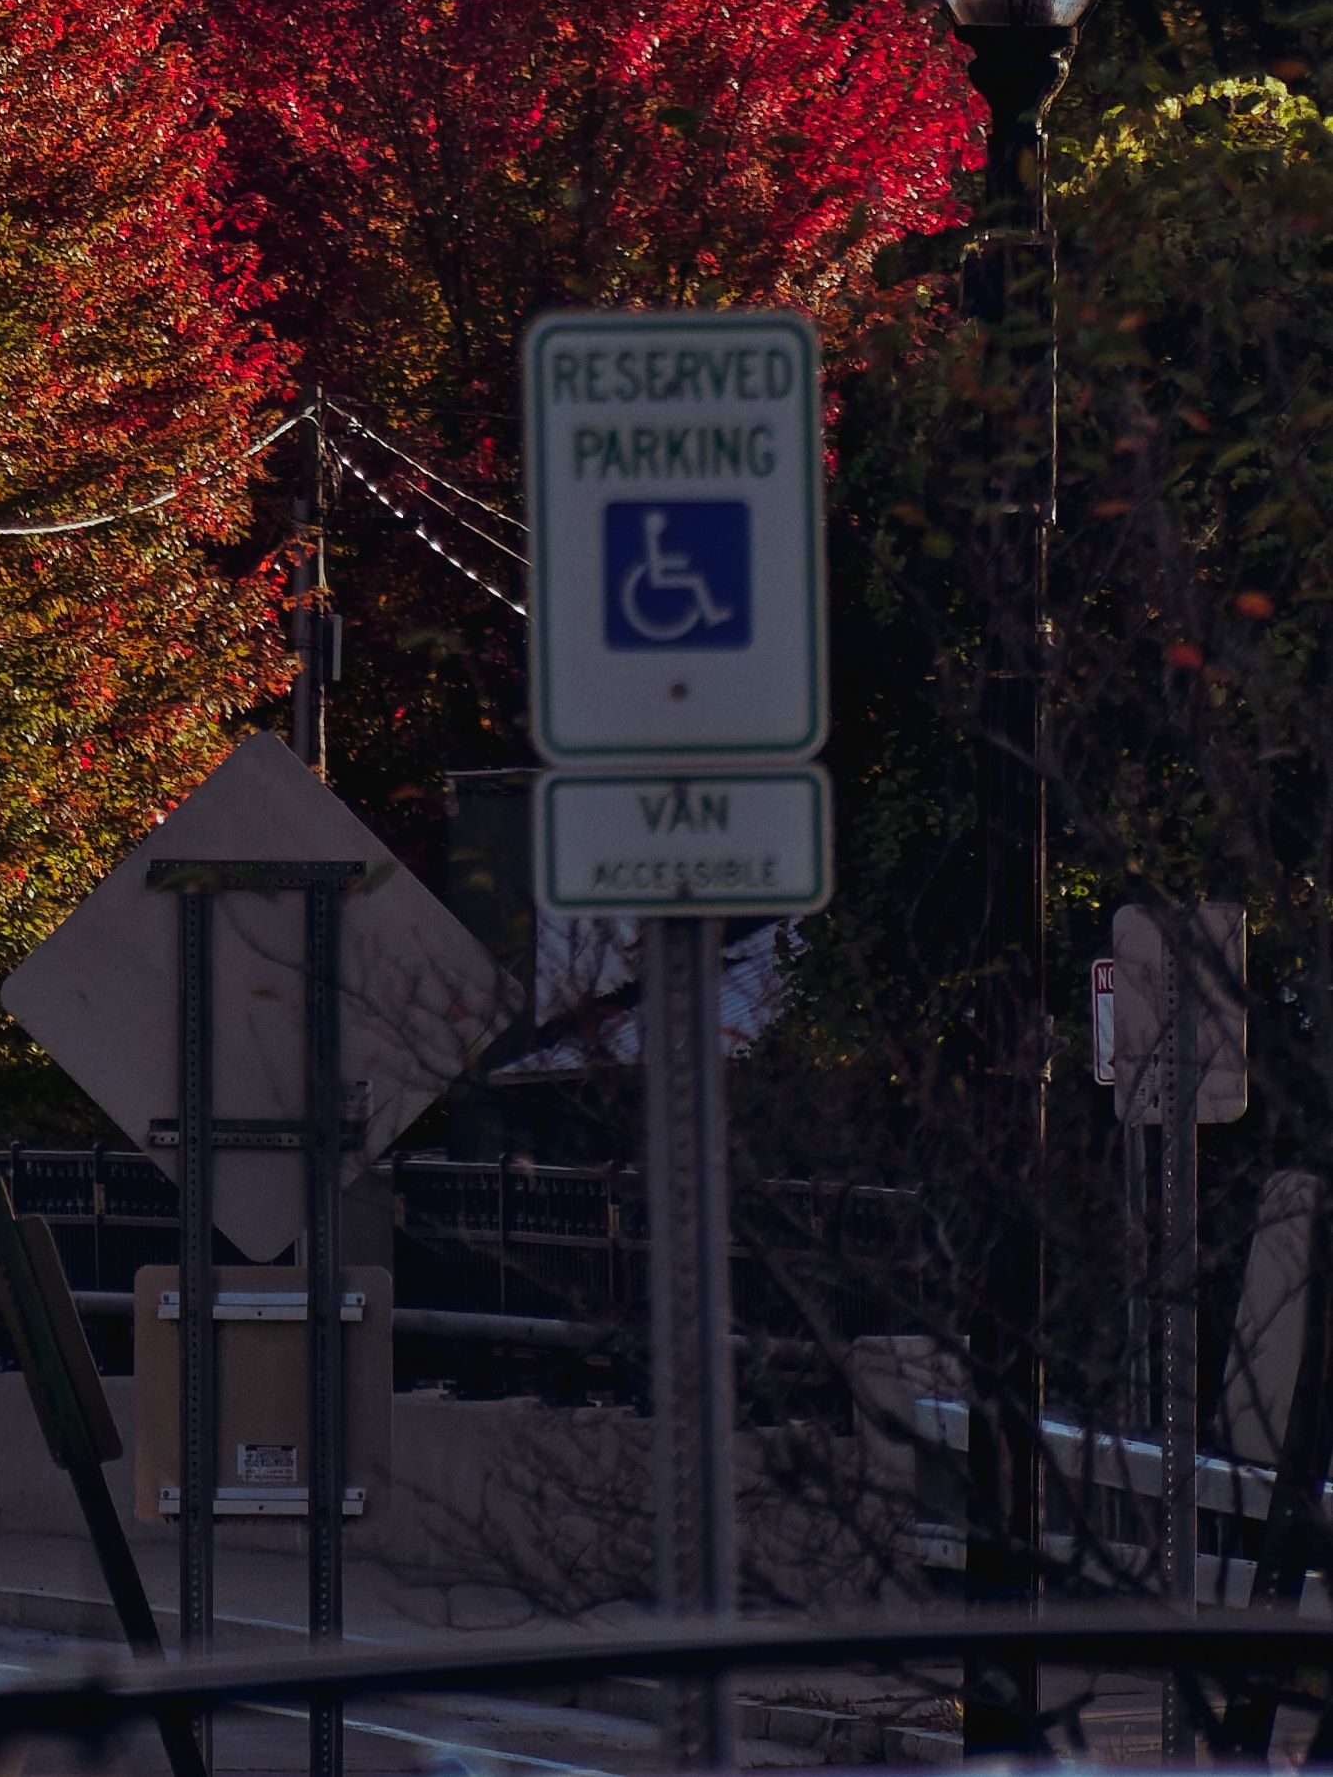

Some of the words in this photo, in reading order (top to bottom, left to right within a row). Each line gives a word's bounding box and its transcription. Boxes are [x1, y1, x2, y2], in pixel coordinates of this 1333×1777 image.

[553, 350, 793, 403] RESERVED
[573, 424, 776, 479] PARKING
[639, 794, 729, 833] VAN
[592, 856, 779, 889] ACCESSIBLE
